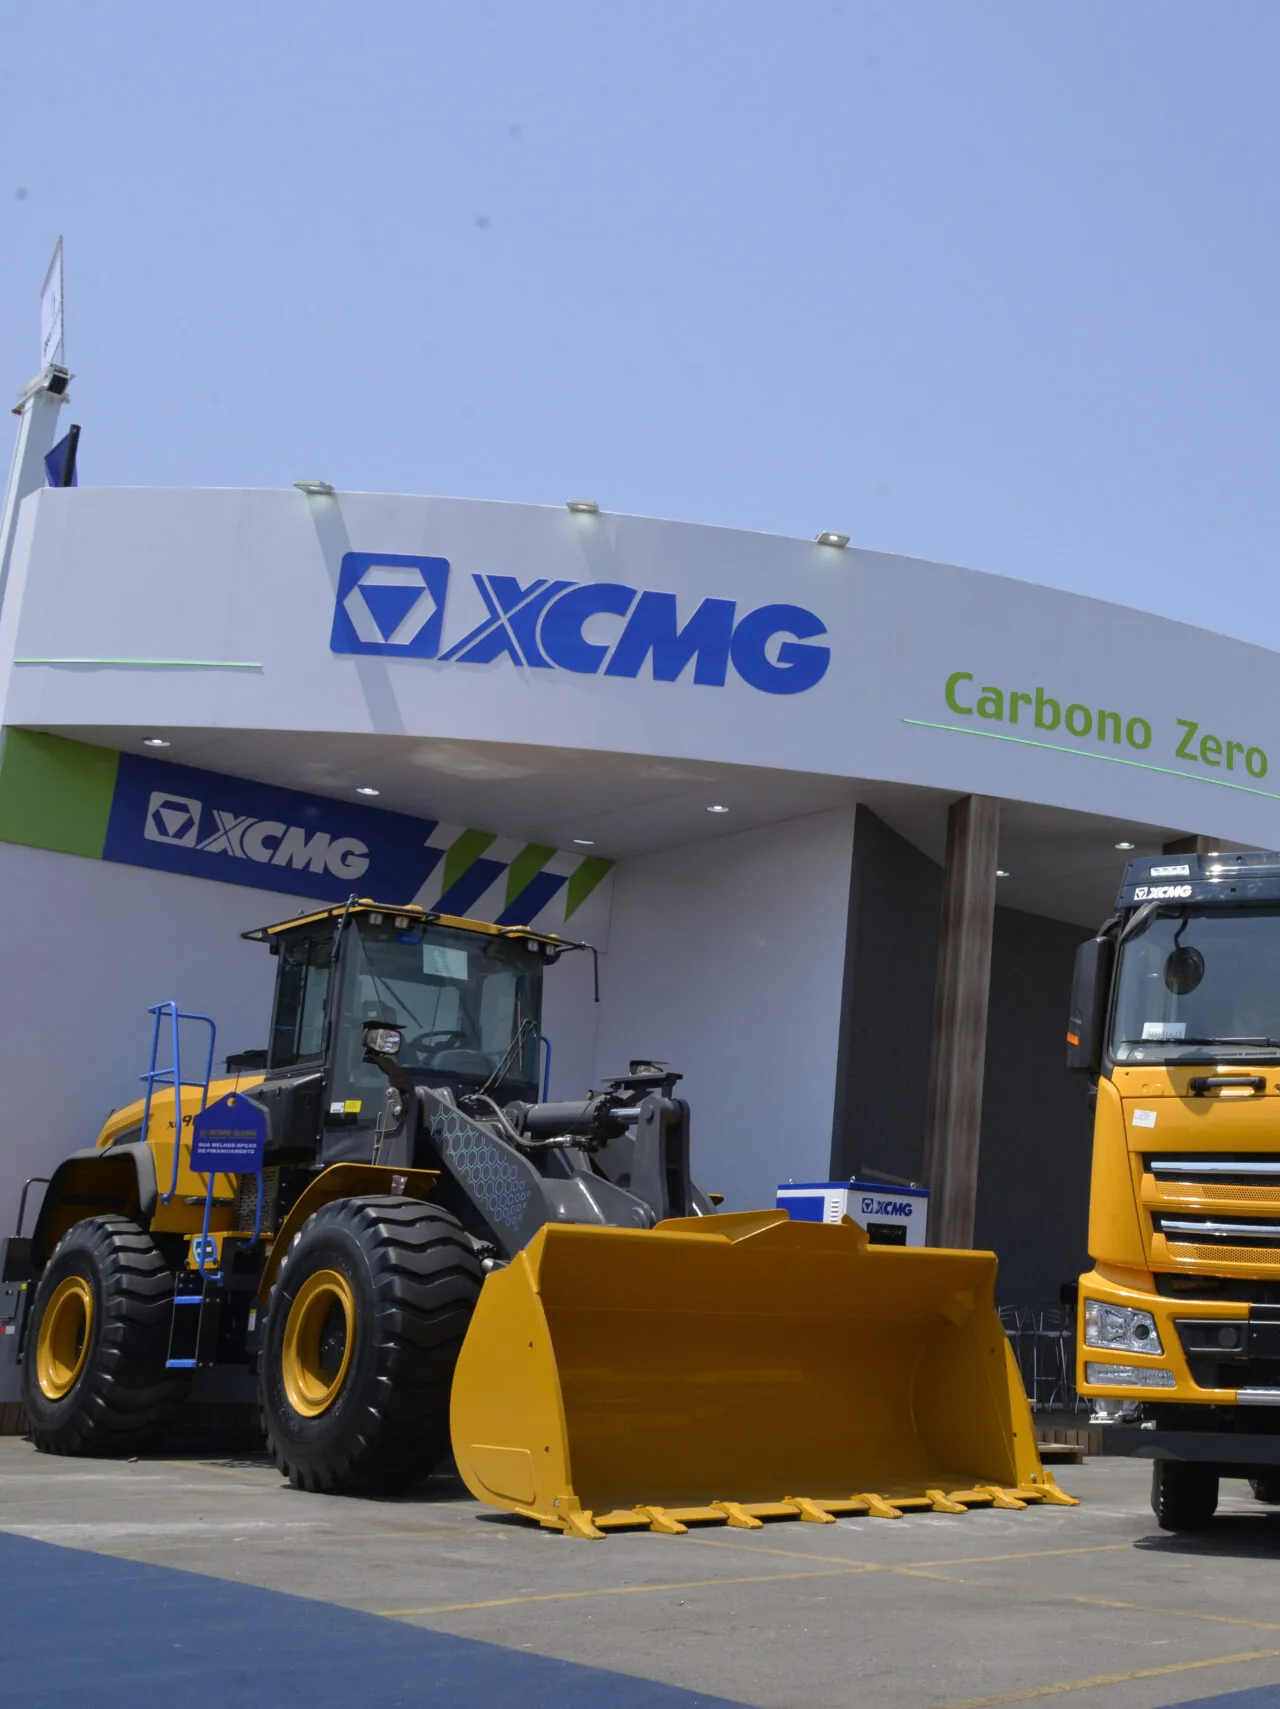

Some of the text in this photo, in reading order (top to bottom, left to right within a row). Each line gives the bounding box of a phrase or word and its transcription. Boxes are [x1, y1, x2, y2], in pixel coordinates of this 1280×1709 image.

[437, 573, 831, 696] XCMG
[944, 671, 1269, 778] Carbono Zero
[201, 810, 370, 879] XCMG
[1146, 885, 1192, 899] XCMG
[873, 1200, 913, 1217] XCMG
